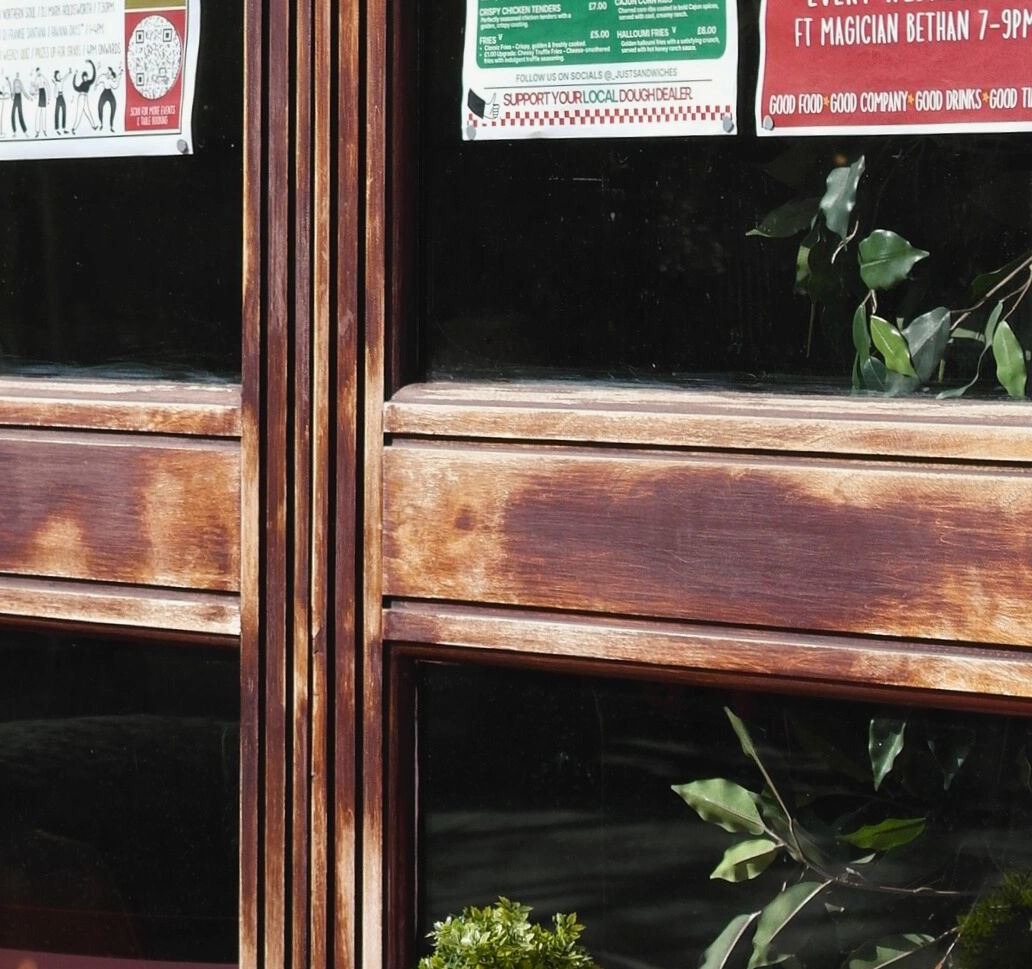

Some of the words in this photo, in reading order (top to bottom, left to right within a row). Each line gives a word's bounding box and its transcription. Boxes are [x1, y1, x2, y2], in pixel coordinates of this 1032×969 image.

[479, 7, 501, 17] CRISPY
[501, 5, 531, 15] CHICKEN
[531, 4, 562, 13] TENDERS
[588, 1, 608, 11] £7.00
[616, 29, 651, 39] HALLOUMI
[650, 28, 670, 38] FRIES
[795, 18, 813, 47] FT
[821, 13, 899, 47] MAGICIAN
[906, 9, 969, 43] BETHAN
[479, 35, 497, 45] FRIES
[590, 30, 610, 39] £5.00
[516, 72, 546, 83] FOLLOW
[546, 72, 557, 82] US
[558, 72, 569, 81] ON
[570, 70, 603, 81] SOCIALS
[503, 92, 551, 107] SUPPORT
[551, 90, 582, 105] YOUR
[582, 89, 619, 104] LOCAL
[619, 87, 656, 103] DOUGH
[769, 94, 797, 116] GOOD
[798, 93, 824, 115] FOOD
[829, 92, 857, 115] GOOD
[859, 90, 910, 114] COMPANY
[914, 90, 942, 112] GOOD
[945, 88, 982, 112] DRINKS
[989, 88, 1018, 110] GOOD
